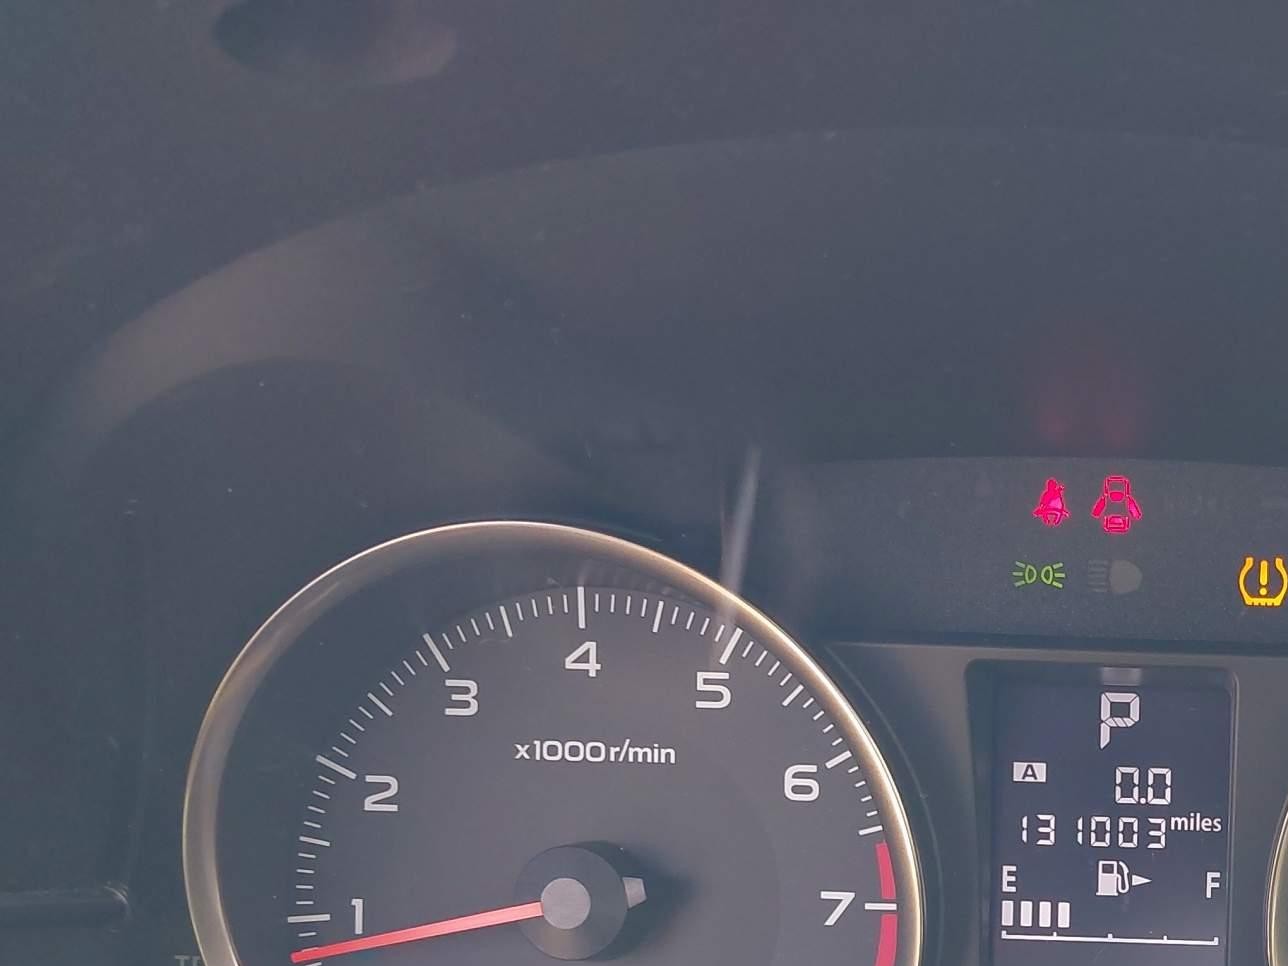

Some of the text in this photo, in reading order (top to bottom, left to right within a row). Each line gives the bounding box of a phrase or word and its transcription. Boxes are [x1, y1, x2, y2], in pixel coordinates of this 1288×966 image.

[565, 641, 601, 678] 4
[445, 679, 478, 716] 3
[695, 672, 731, 708] 5
[1100, 692, 1140, 749] P
[784, 765, 820, 801] 6
[1022, 764, 1038, 780] A
[1115, 767, 1172, 804] 0.0
[364, 775, 399, 811] 2
[1170, 812, 1222, 832] miles
[1002, 866, 1017, 893] E
[1206, 872, 1221, 898] F
[351, 899, 364, 934] 1
[820, 891, 855, 926] 7
